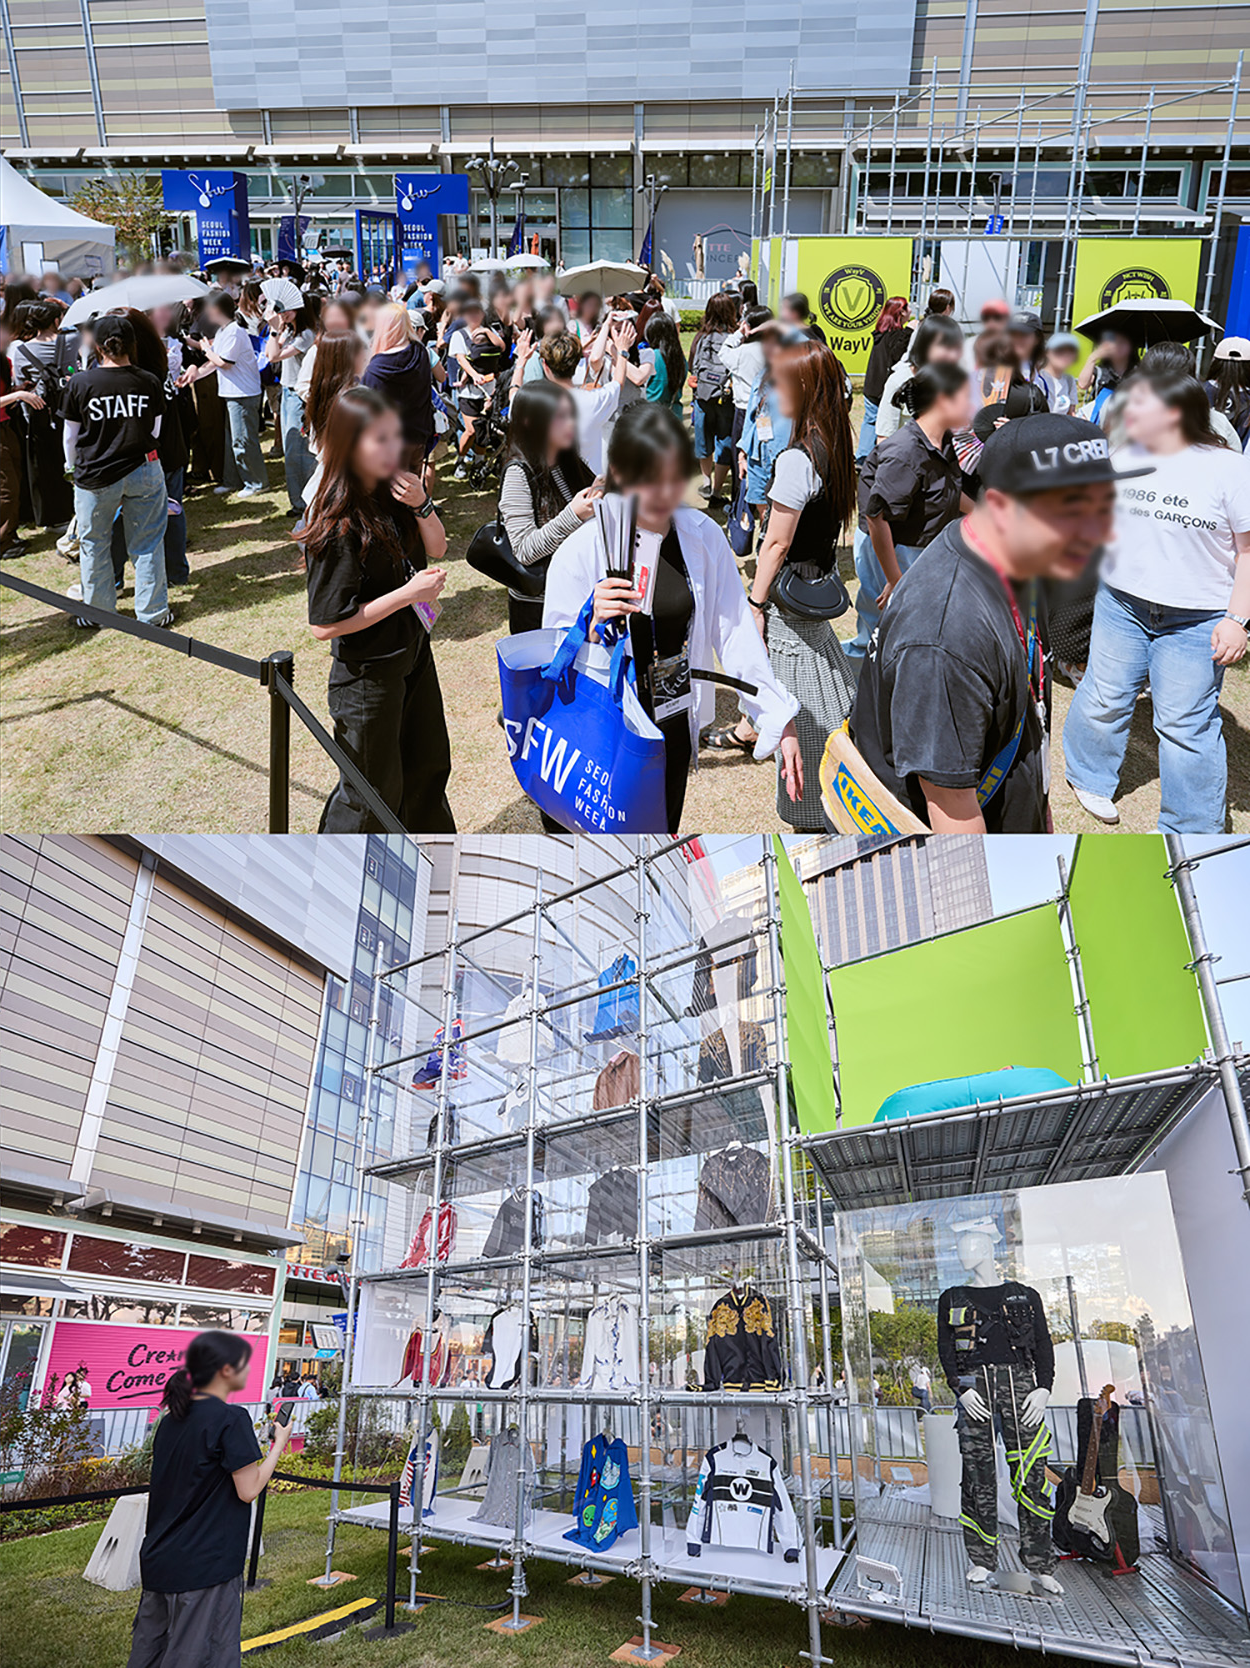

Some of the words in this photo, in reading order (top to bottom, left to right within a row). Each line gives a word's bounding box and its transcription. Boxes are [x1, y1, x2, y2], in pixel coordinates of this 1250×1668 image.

[201, 221, 224, 229] SEOUL
[403, 224, 425, 232] SEOUL
[830, 336, 871, 355] WayV
[88, 394, 149, 421] STAFF
[1031, 446, 1061, 471] L7
[1162, 494, 1189, 509] été
[1154, 510, 1218, 531] GARÇONS
[503, 716, 582, 795] SFW
[841, 776, 889, 834] IKEA
[106, 1370, 167, 1393] Come
[733, 1482, 751, 1497] W
